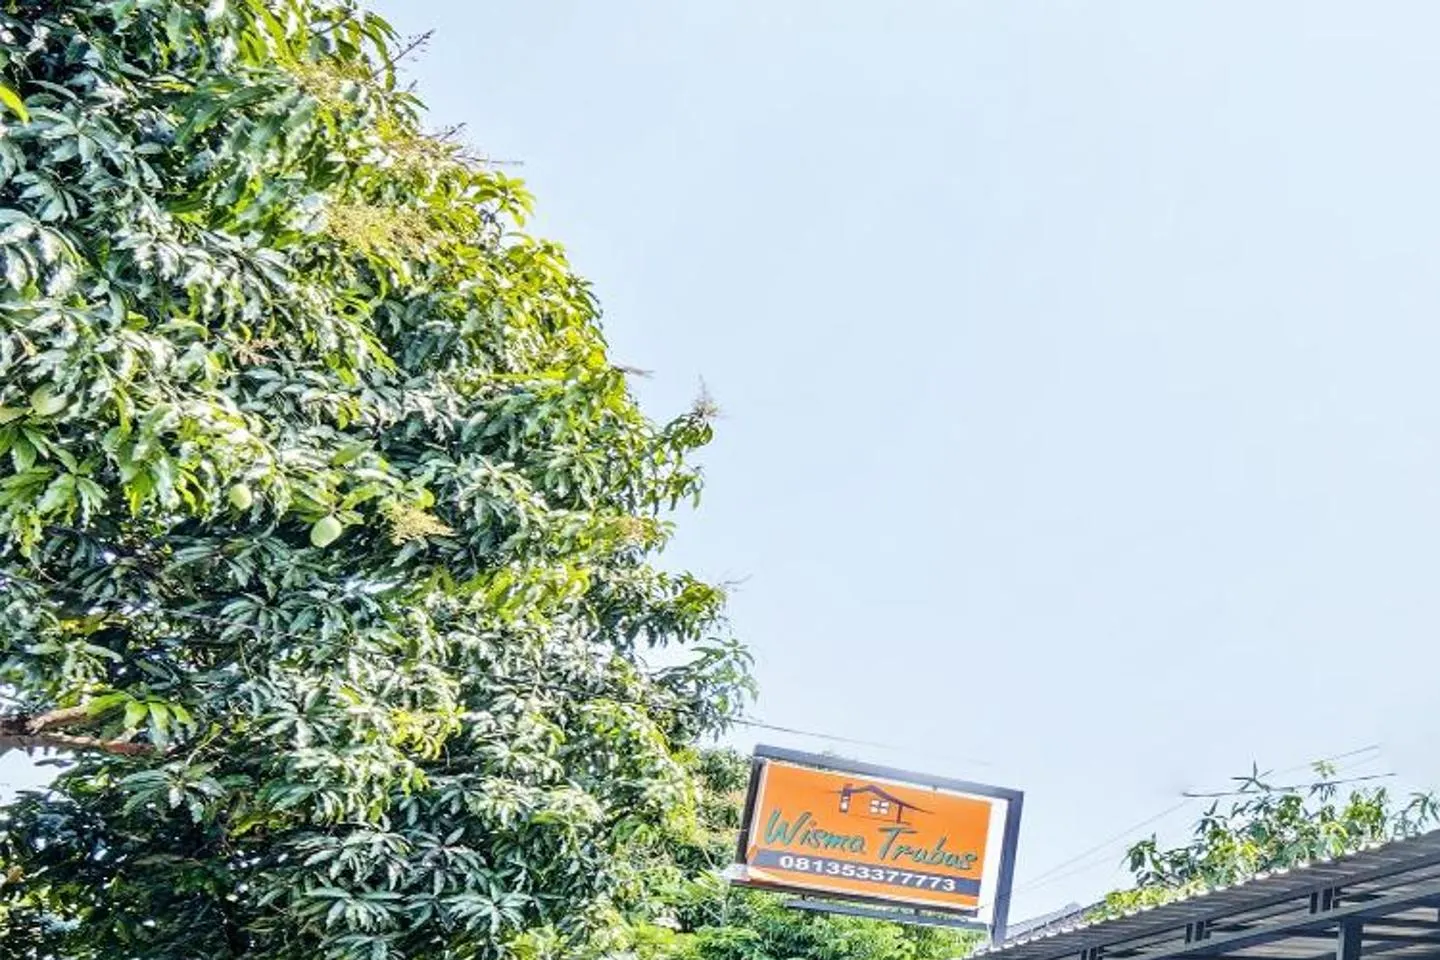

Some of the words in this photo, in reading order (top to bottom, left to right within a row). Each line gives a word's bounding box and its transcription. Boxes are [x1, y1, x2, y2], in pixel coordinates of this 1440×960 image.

[764, 808, 866, 854] Wisma
[878, 826, 978, 870] Trubus
[779, 855, 956, 892] 081353377773
